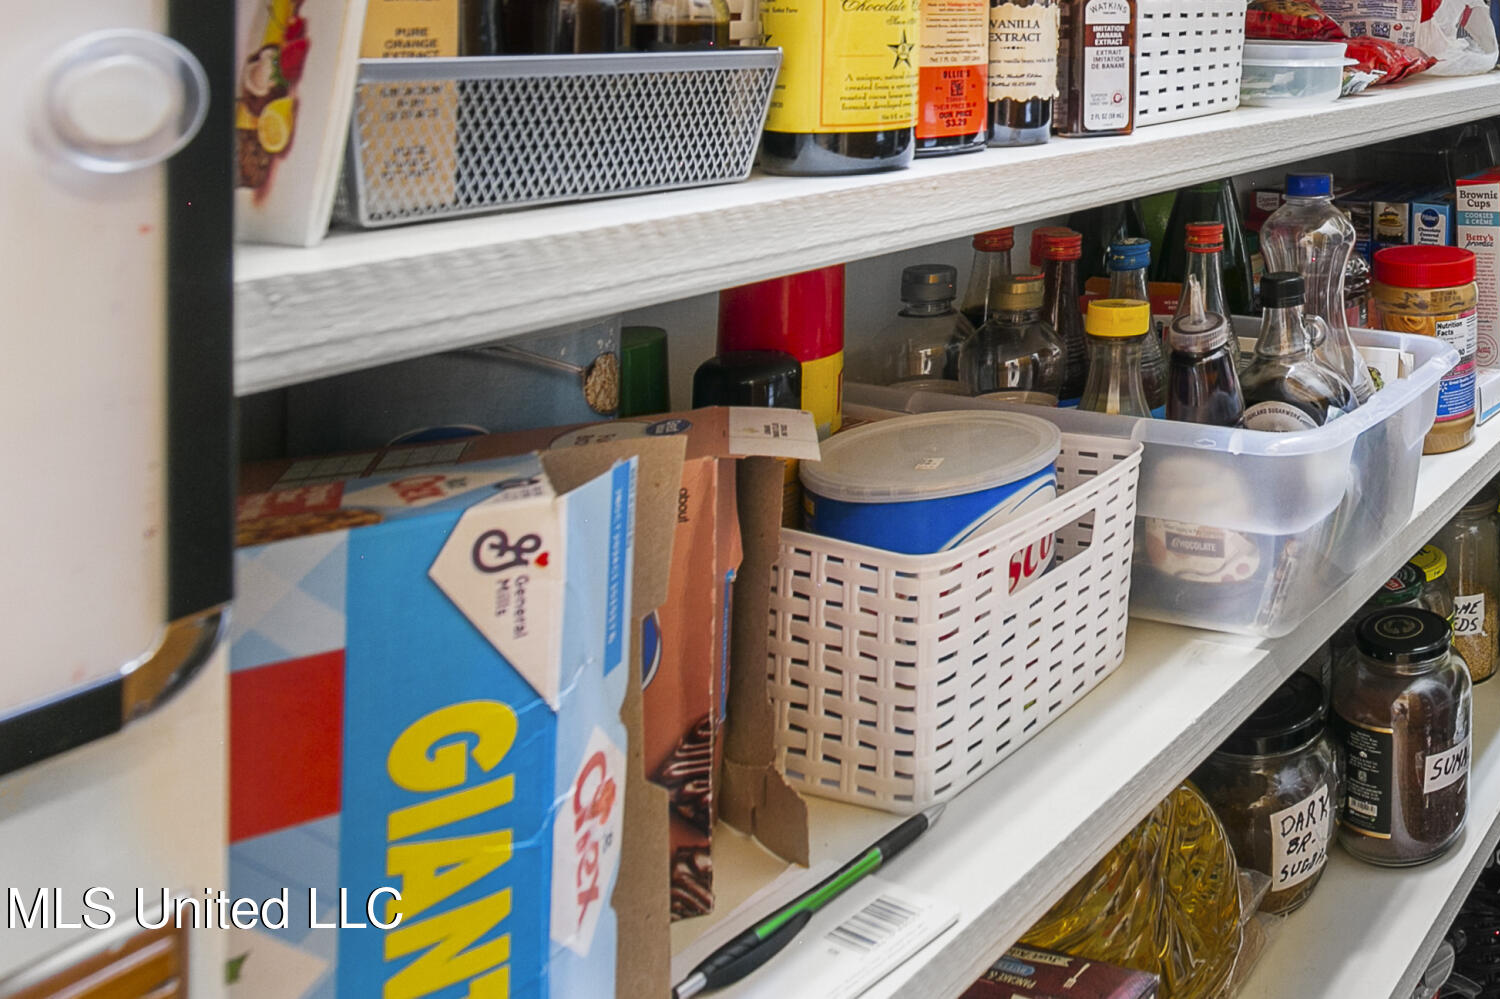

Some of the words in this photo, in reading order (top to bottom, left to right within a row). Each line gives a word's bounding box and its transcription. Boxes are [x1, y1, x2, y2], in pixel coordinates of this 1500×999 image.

[1089, 1, 1128, 14] WATKINS
[989, 19, 1040, 30] VANILLA
[989, 32, 1041, 43] EXTRACT
[1460, 190, 1498, 200] Brownie
[1467, 199, 1491, 210] Cups
[1437, 321, 1462, 330] Nutrition
[1437, 329, 1454, 337] Facts
[678, 488, 690, 524] about
[383, 699, 518, 999] GIAN
